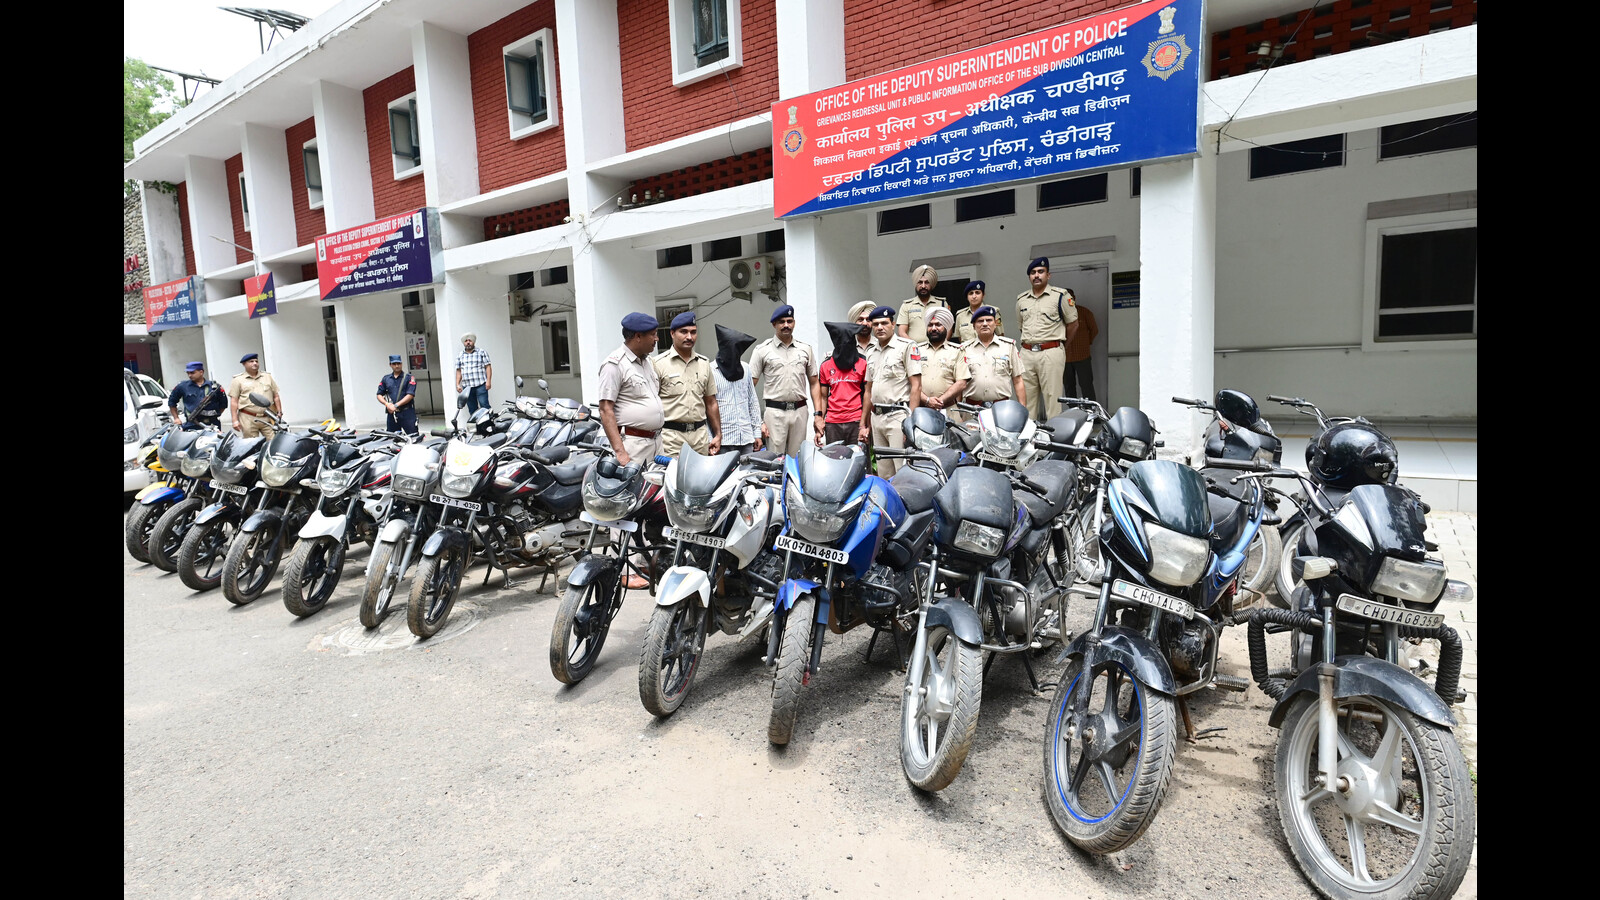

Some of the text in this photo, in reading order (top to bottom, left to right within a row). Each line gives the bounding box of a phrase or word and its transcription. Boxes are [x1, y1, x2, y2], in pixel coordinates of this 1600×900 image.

[815, 17, 1128, 113] OFFICE OF THE DEPUTY SUPERINTENDENT OF POLICE
[816, 45, 1125, 127] GRIEVANCES REDRESSAL UNIT & PUBLIC INFORMATION OFFICE OF THE SUB DIVISION CENTRAL
[813, 94, 1131, 167] शिकायत निवारण इकाई एवं जन सूचना अधिकारी, केन्द्रीय सब डिवीज़न
[816, 126, 870, 149] कार्यालय
[876, 116, 917, 141] पुलिस
[921, 109, 947, 126] उप
[965, 88, 1036, 118] अधीक्षक
[1043, 68, 1128, 99] चण्डीगढ़
[822, 121, 1116, 187] ਦਫ਼ਤਰ ਡਿਪਟੀ ਸੁਪਰਡੰਟ ਪੁਲਿਸ, ਚੰਡੀਗੜ੍ਹ
[913, 174, 929, 186] ਅਤੇ
[932, 173, 947, 183] ਜਨ
[777, 536, 792, 548] UK
